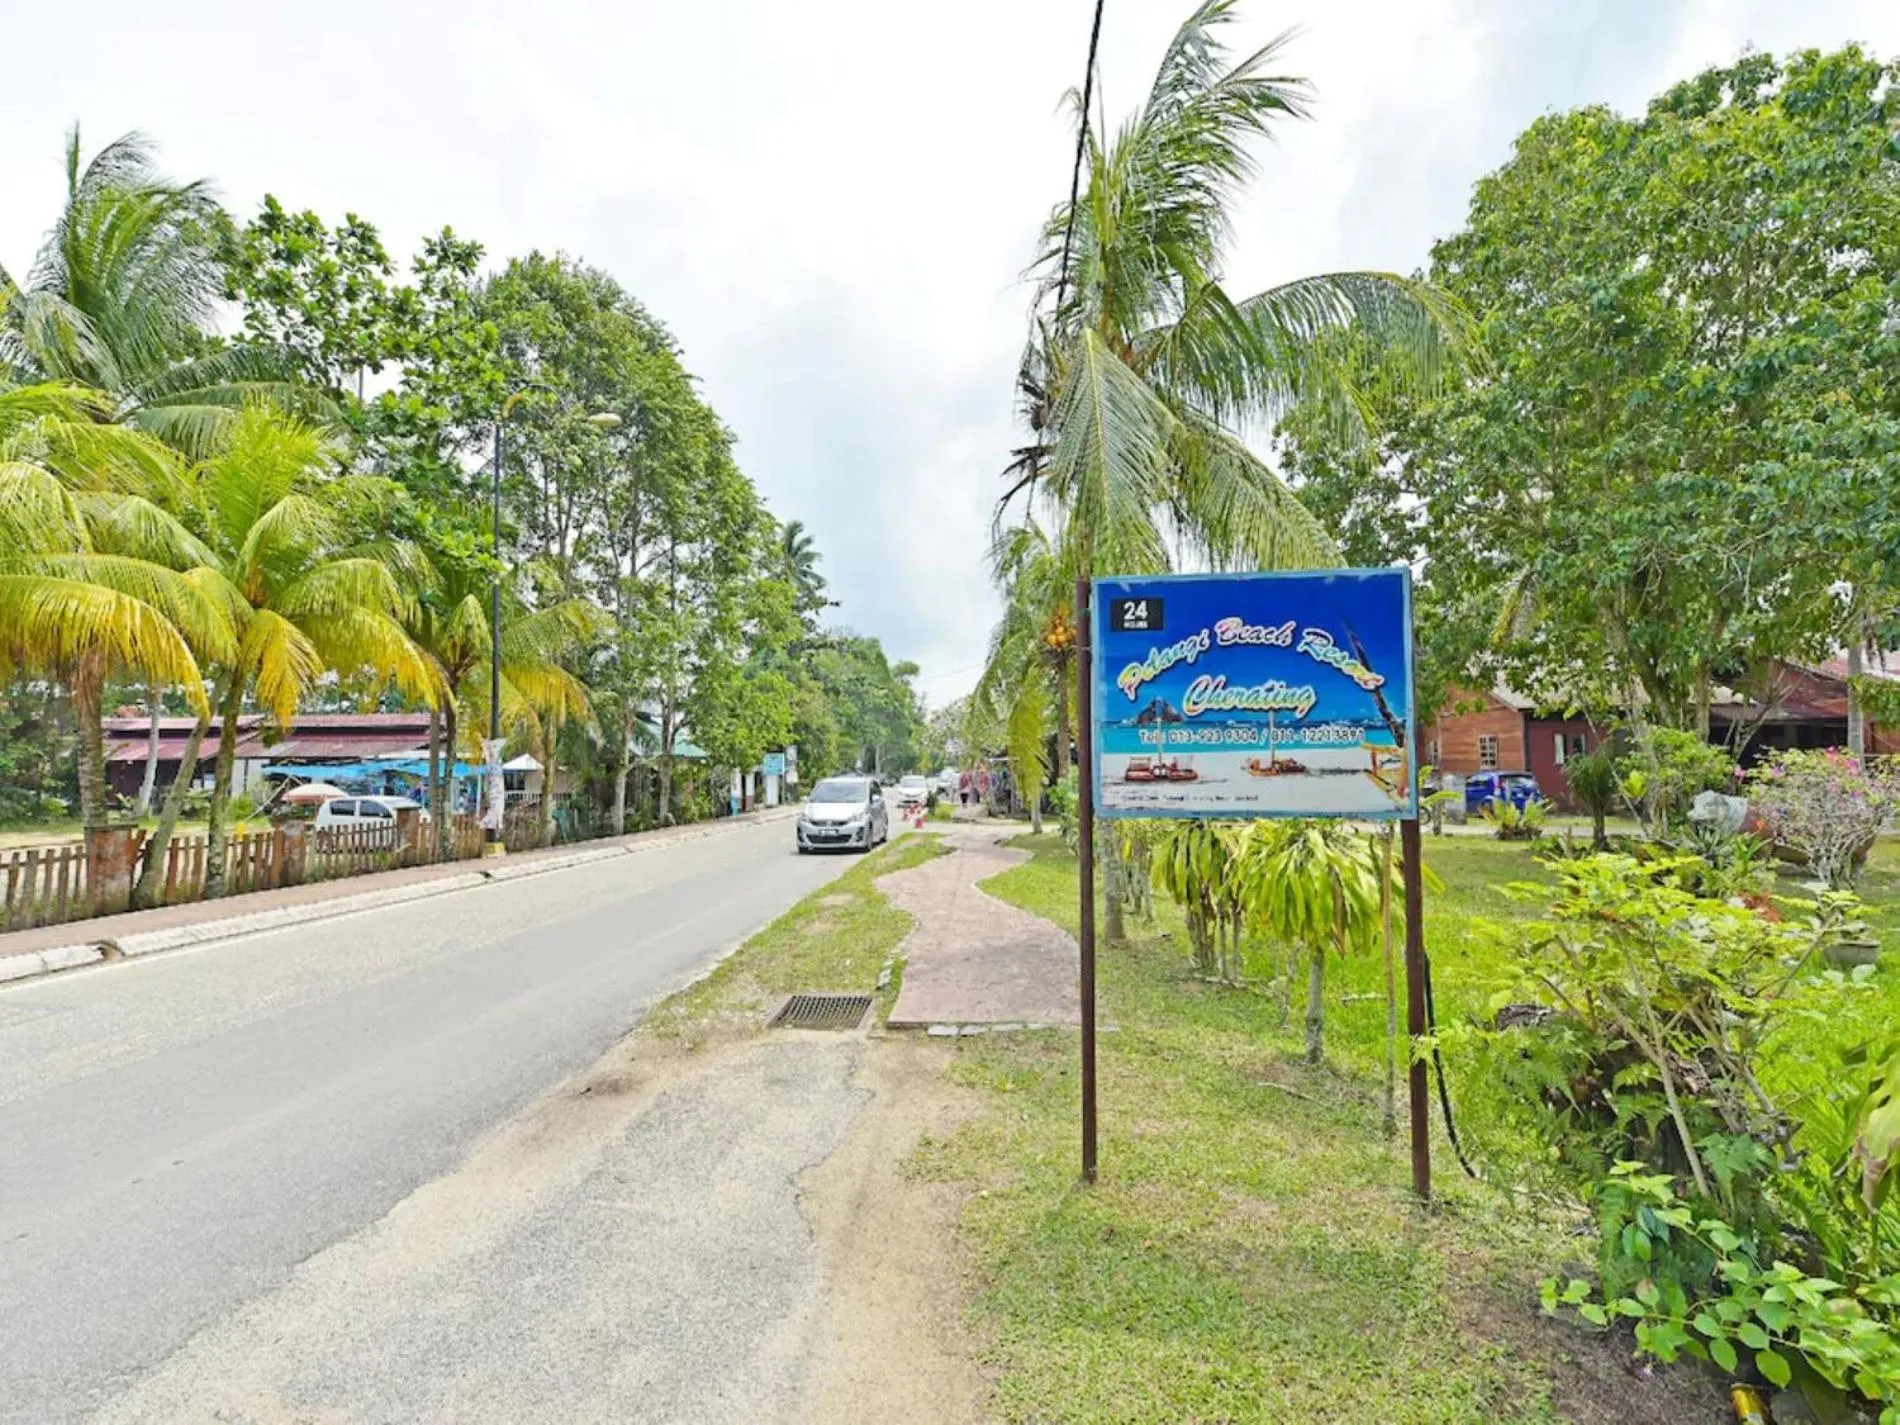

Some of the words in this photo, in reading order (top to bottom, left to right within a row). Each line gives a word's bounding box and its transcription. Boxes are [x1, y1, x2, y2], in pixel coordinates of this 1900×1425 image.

[1123, 600, 1148, 620] 24
[1214, 617, 1297, 647] Beach
[1183, 674, 1317, 717] Cherating
